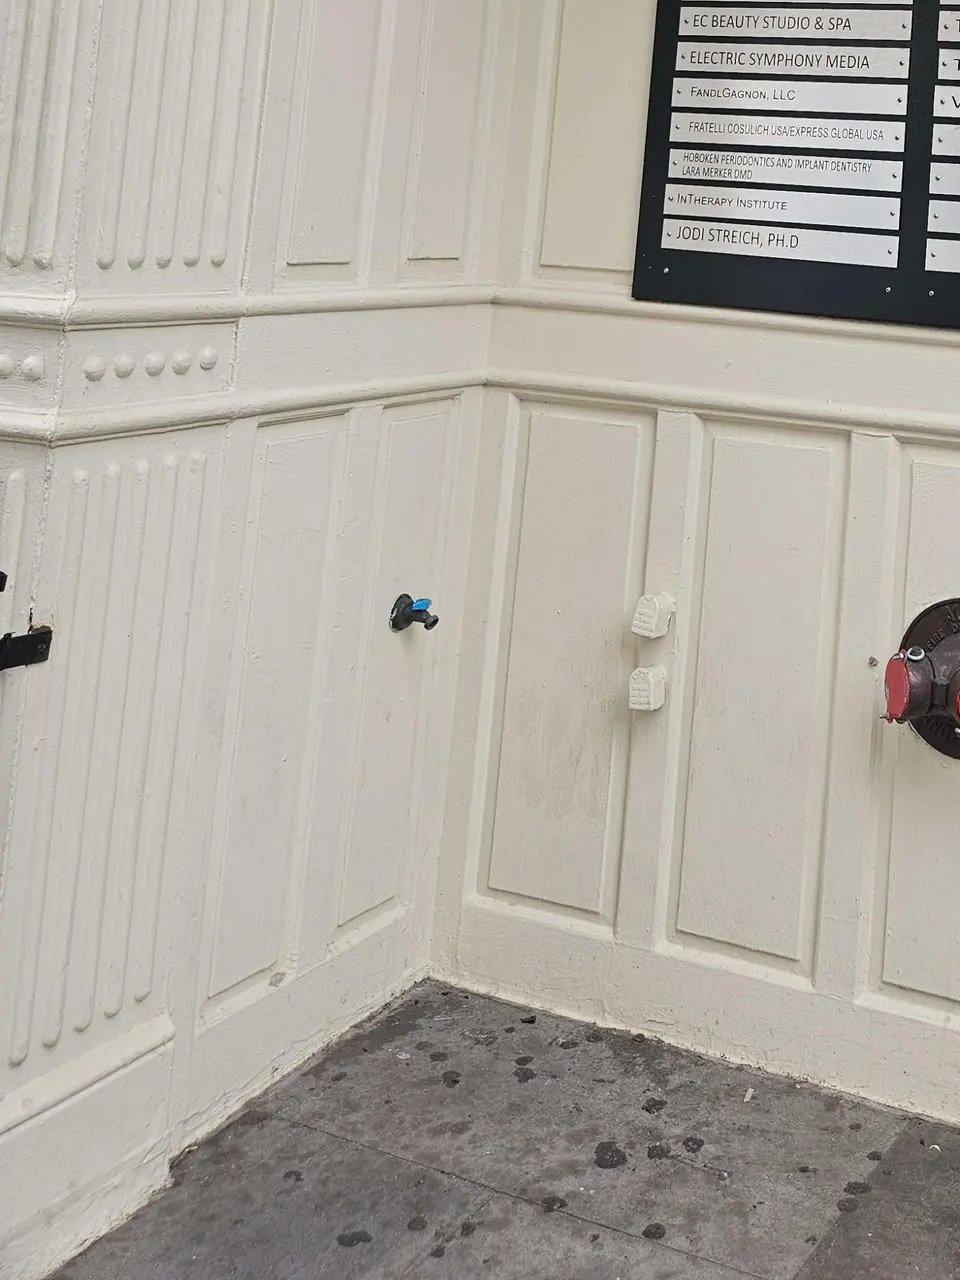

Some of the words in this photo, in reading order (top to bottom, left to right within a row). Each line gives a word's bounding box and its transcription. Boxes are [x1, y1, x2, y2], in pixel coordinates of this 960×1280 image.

[693, 15, 708, 27] EC
[712, 15, 759, 28] BEAUTY
[763, 16, 810, 29] STUDIO
[814, 17, 823, 30] &
[828, 17, 851, 30] SPA
[690, 51, 745, 65] ELECTRIC
[749, 53, 822, 67] SYMPHONY
[826, 55, 869, 68] MEDIA
[773, 90, 795, 100] LLC
[689, 122, 725, 133] FRATELLI
[728, 123, 769, 135] COSULICH
[831, 128, 864, 139] GLOBAL
[867, 129, 883, 140] USA
[684, 153, 719, 163] HOBOKEN
[720, 154, 775, 167] PERIODONTICS
[776, 158, 792, 168] AND
[795, 157, 829, 170] IMPLANT
[831, 159, 872, 172] DENTISTRY
[682, 166, 700, 176] LARA
[701, 168, 732, 180] MERKER
[733, 169, 752, 181] DMD
[676, 226, 704, 240] JODI
[708, 228, 762, 248] STREICH,
[768, 233, 798, 248] PH.D
